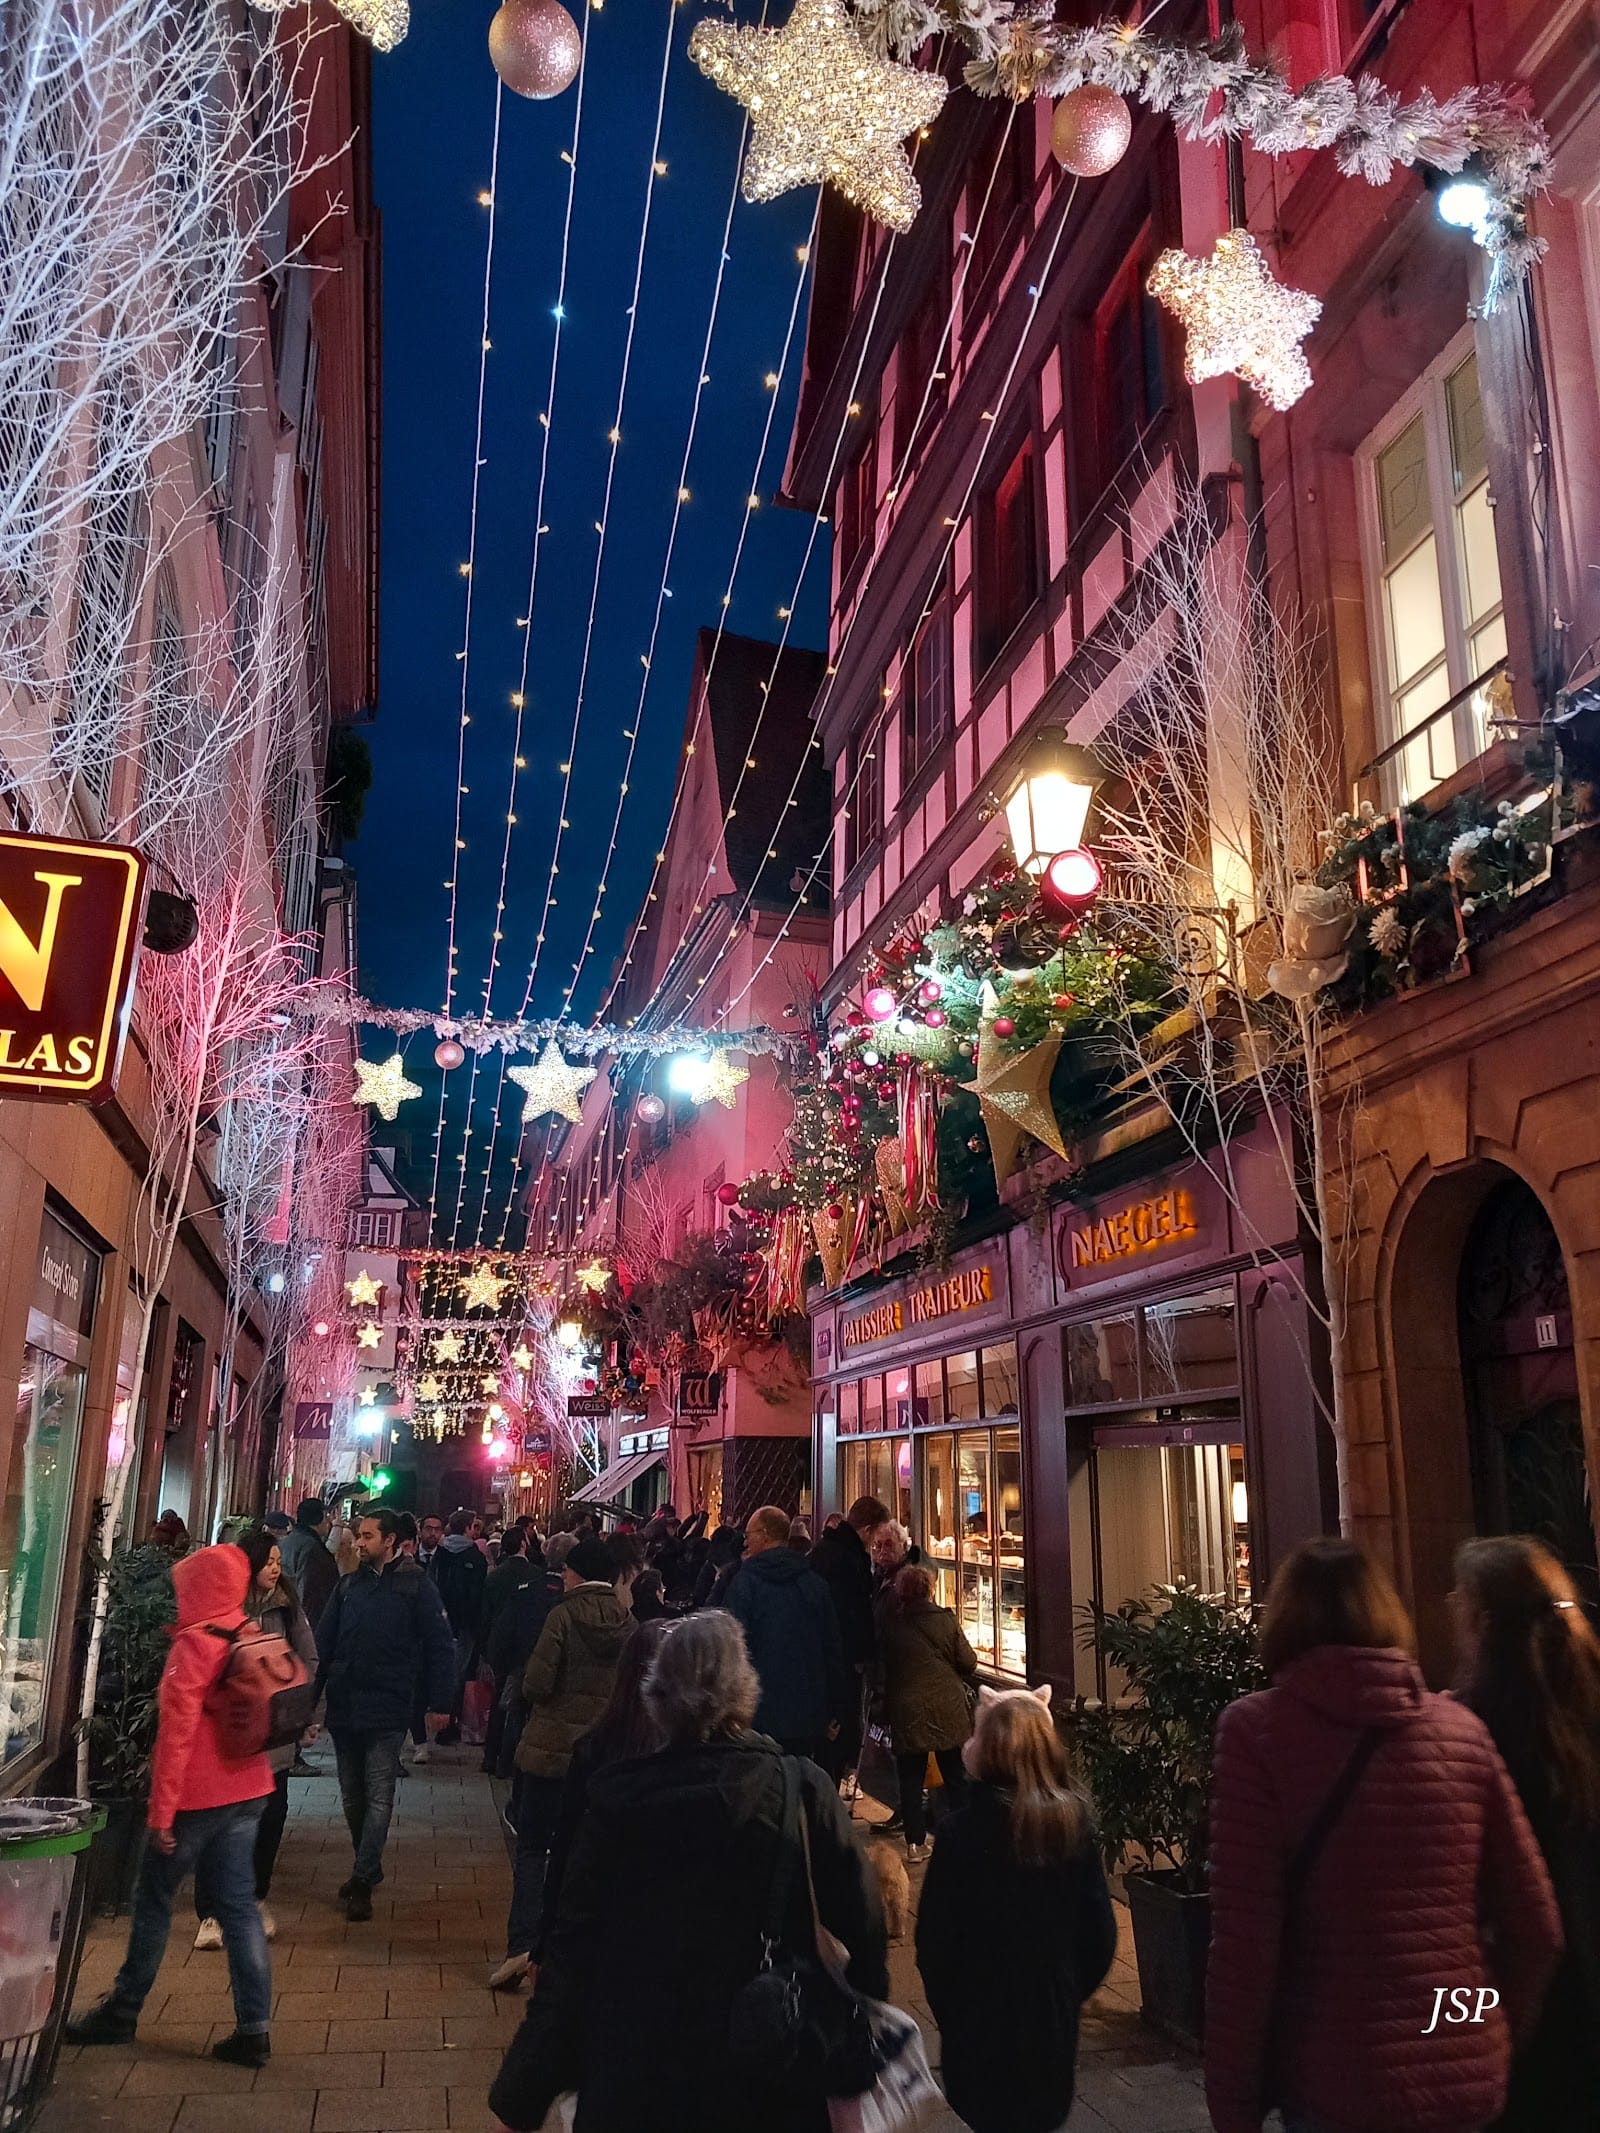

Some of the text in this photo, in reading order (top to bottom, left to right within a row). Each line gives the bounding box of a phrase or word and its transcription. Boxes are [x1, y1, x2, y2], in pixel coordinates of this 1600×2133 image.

[0, 1029, 95, 1075] LAS
[1071, 1190, 1188, 1268] NAEGEL
[41, 1245, 79, 1301] Concept Store
[909, 1268, 986, 1324] TRAITEUR
